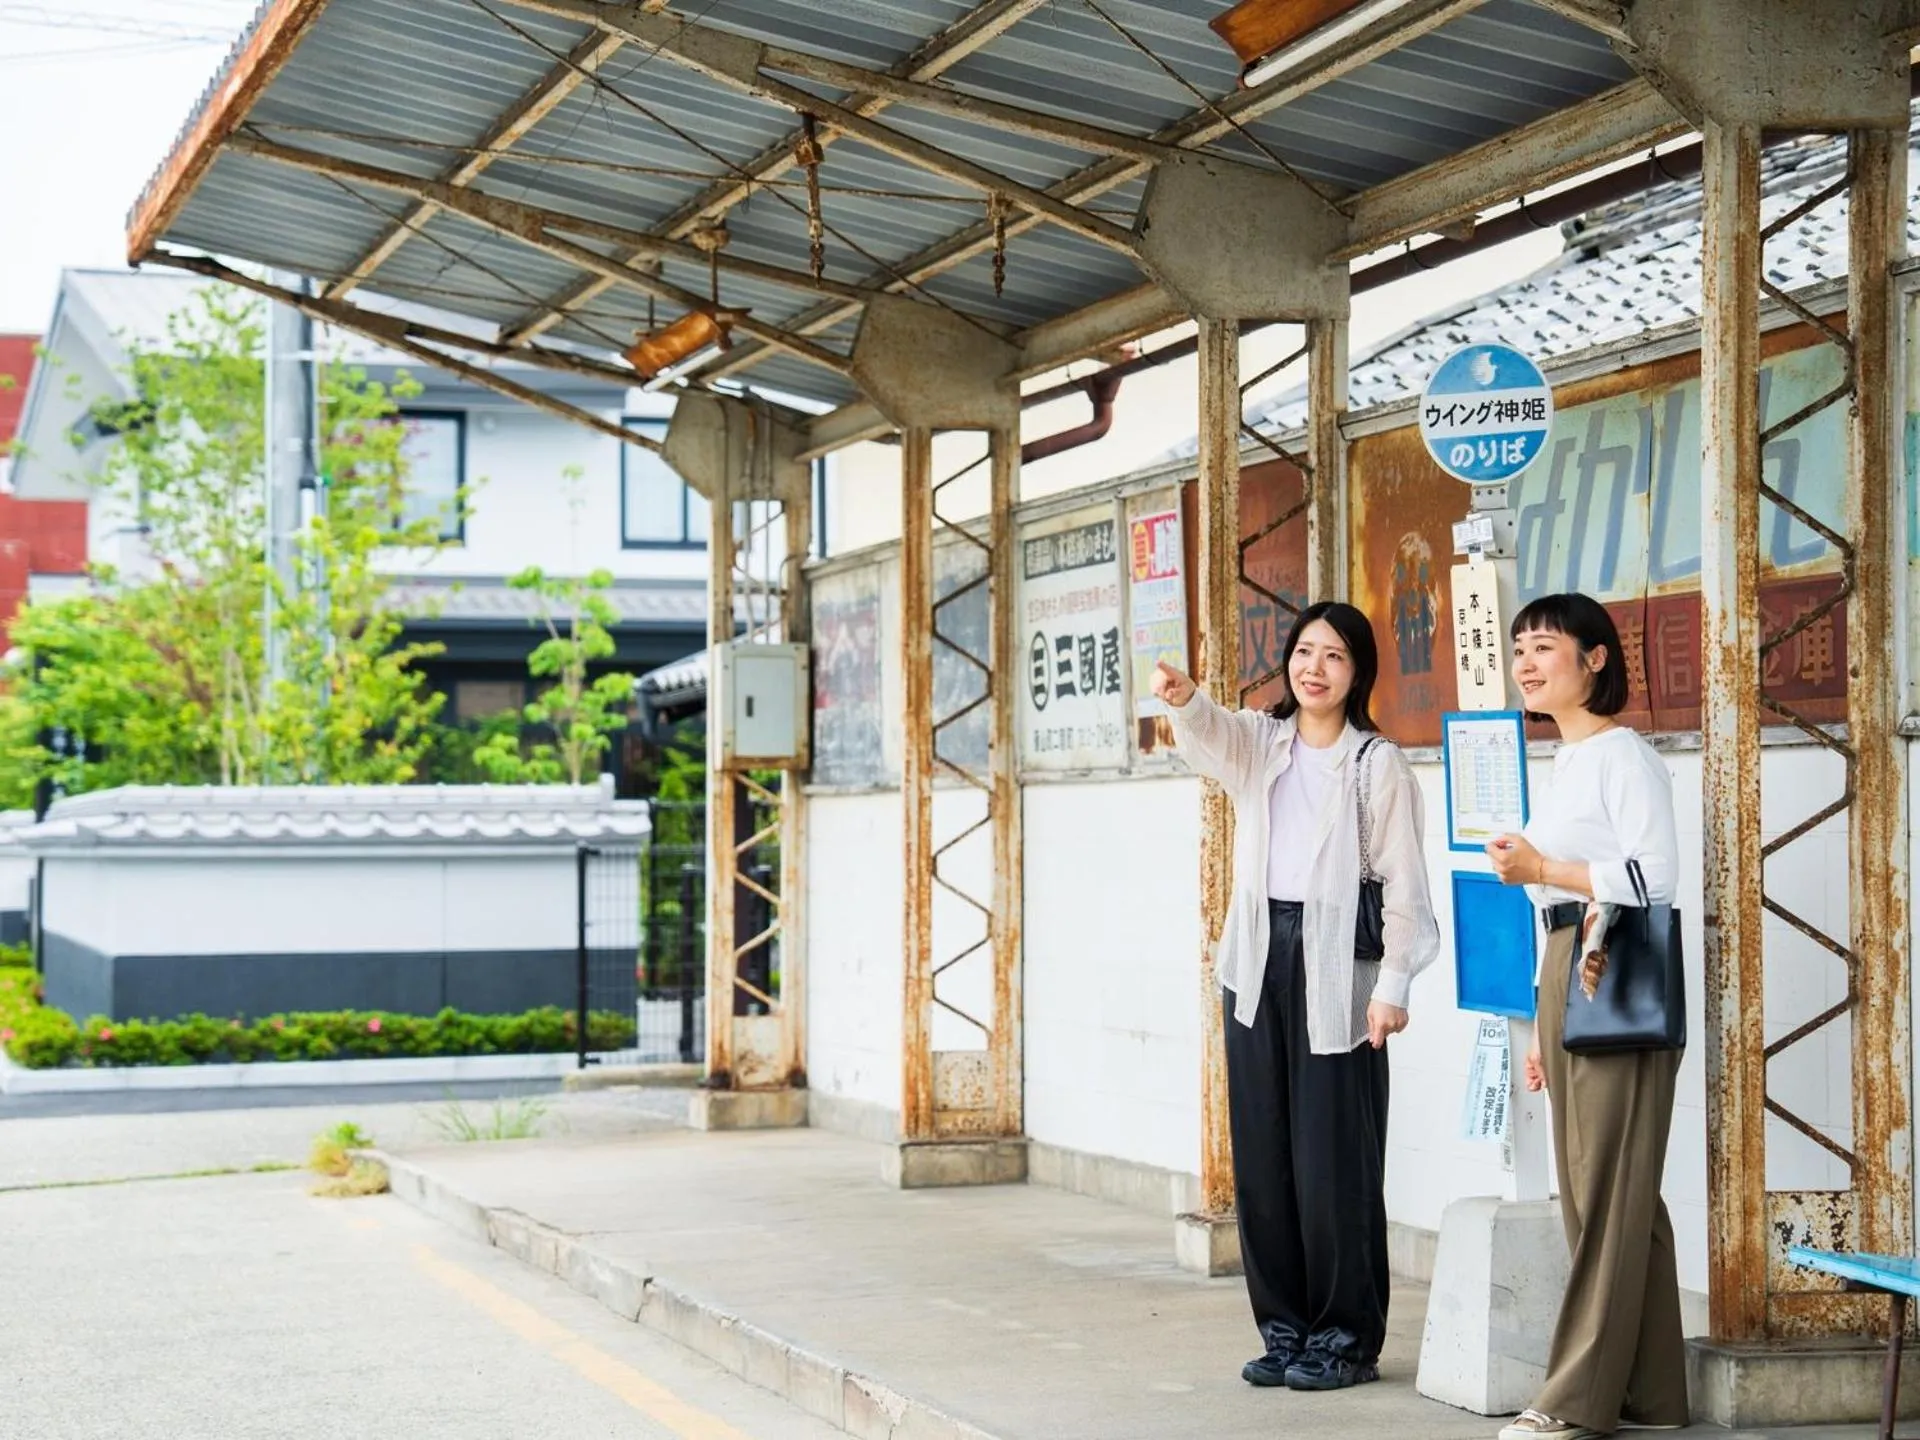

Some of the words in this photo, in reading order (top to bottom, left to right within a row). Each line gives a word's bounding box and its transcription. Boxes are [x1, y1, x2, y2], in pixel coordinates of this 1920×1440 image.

[1425, 398, 1546, 428] ウイング神姫
[1450, 436, 1527, 468] のりば
